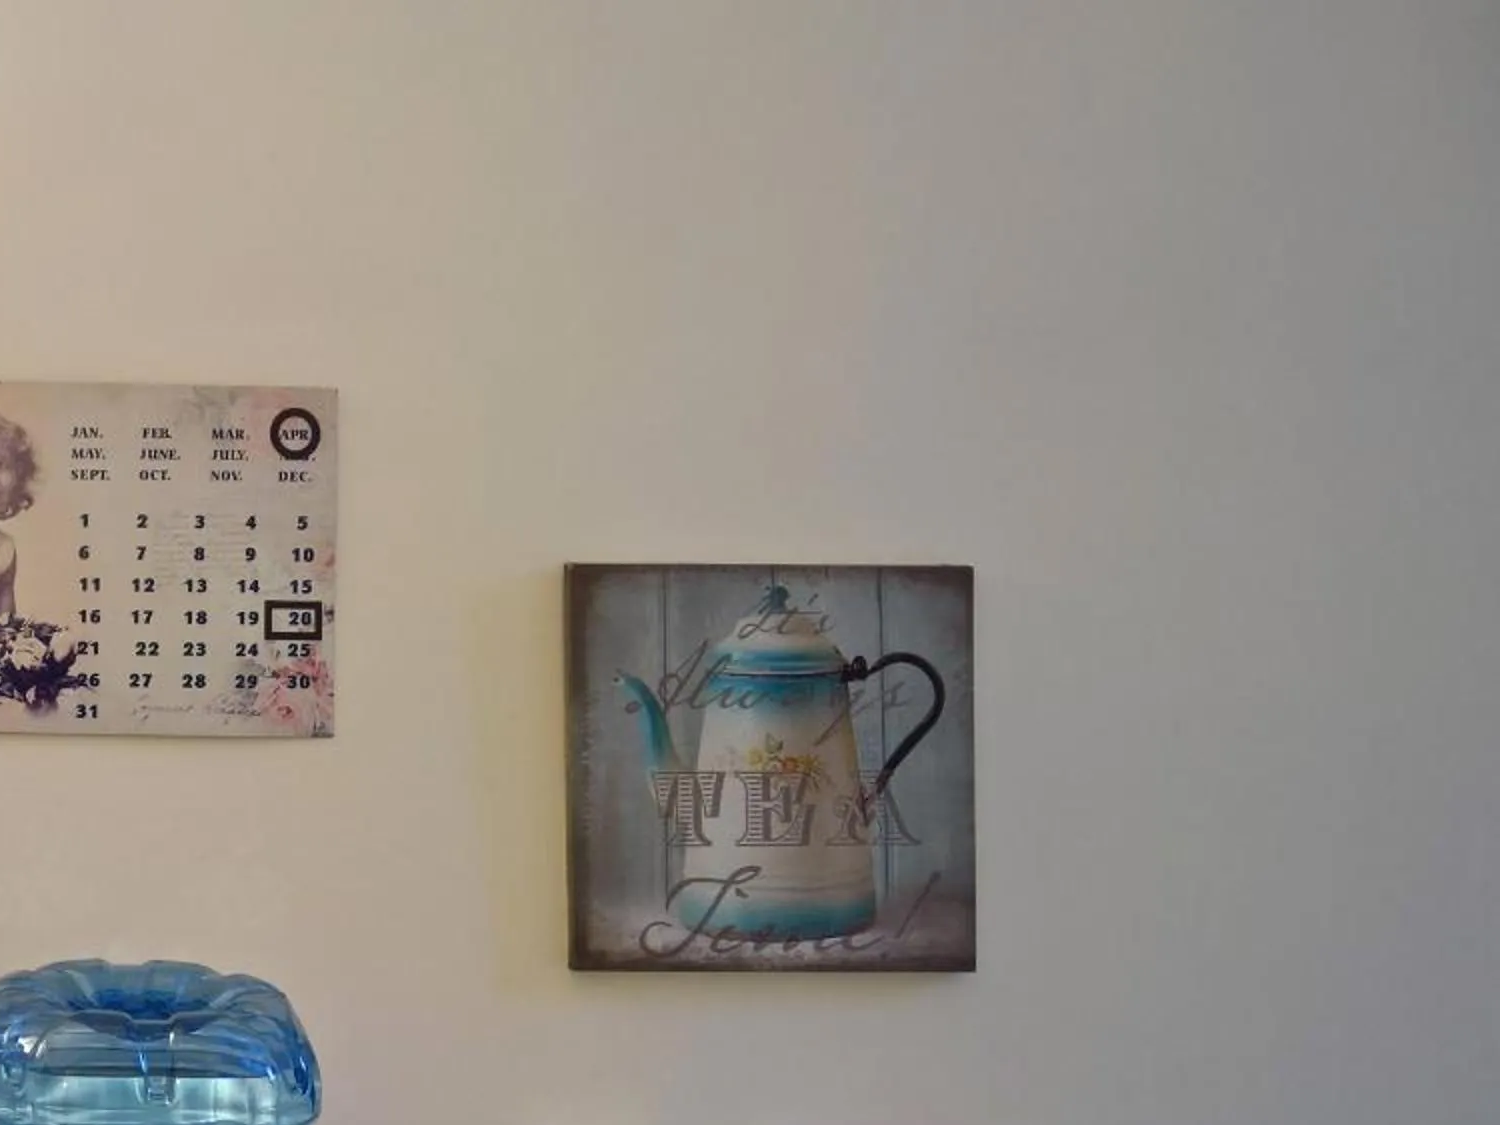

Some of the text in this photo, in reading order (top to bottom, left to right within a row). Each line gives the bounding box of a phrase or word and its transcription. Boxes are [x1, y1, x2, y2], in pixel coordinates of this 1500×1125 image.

[70, 427, 103, 438] JAN.
[212, 428, 249, 440] MAR.
[71, 449, 249, 461] MAY. JUNE. JULY.
[70, 469, 313, 482] SEPT. OCT. NOV. DEC.
[80, 514, 308, 530] 1 2 3 4 5
[79, 546, 315, 562] 6 7 8 9 10
[80, 578, 312, 594] 11 12 13 14 15
[79, 610, 311, 625] 16 17 18 19 20
[77, 642, 310, 656] 21 22 23 24 25
[78, 674, 310, 689] 26 27 28 29 30
[76, 705, 97, 718] 31
[650, 770, 921, 847] TEA
